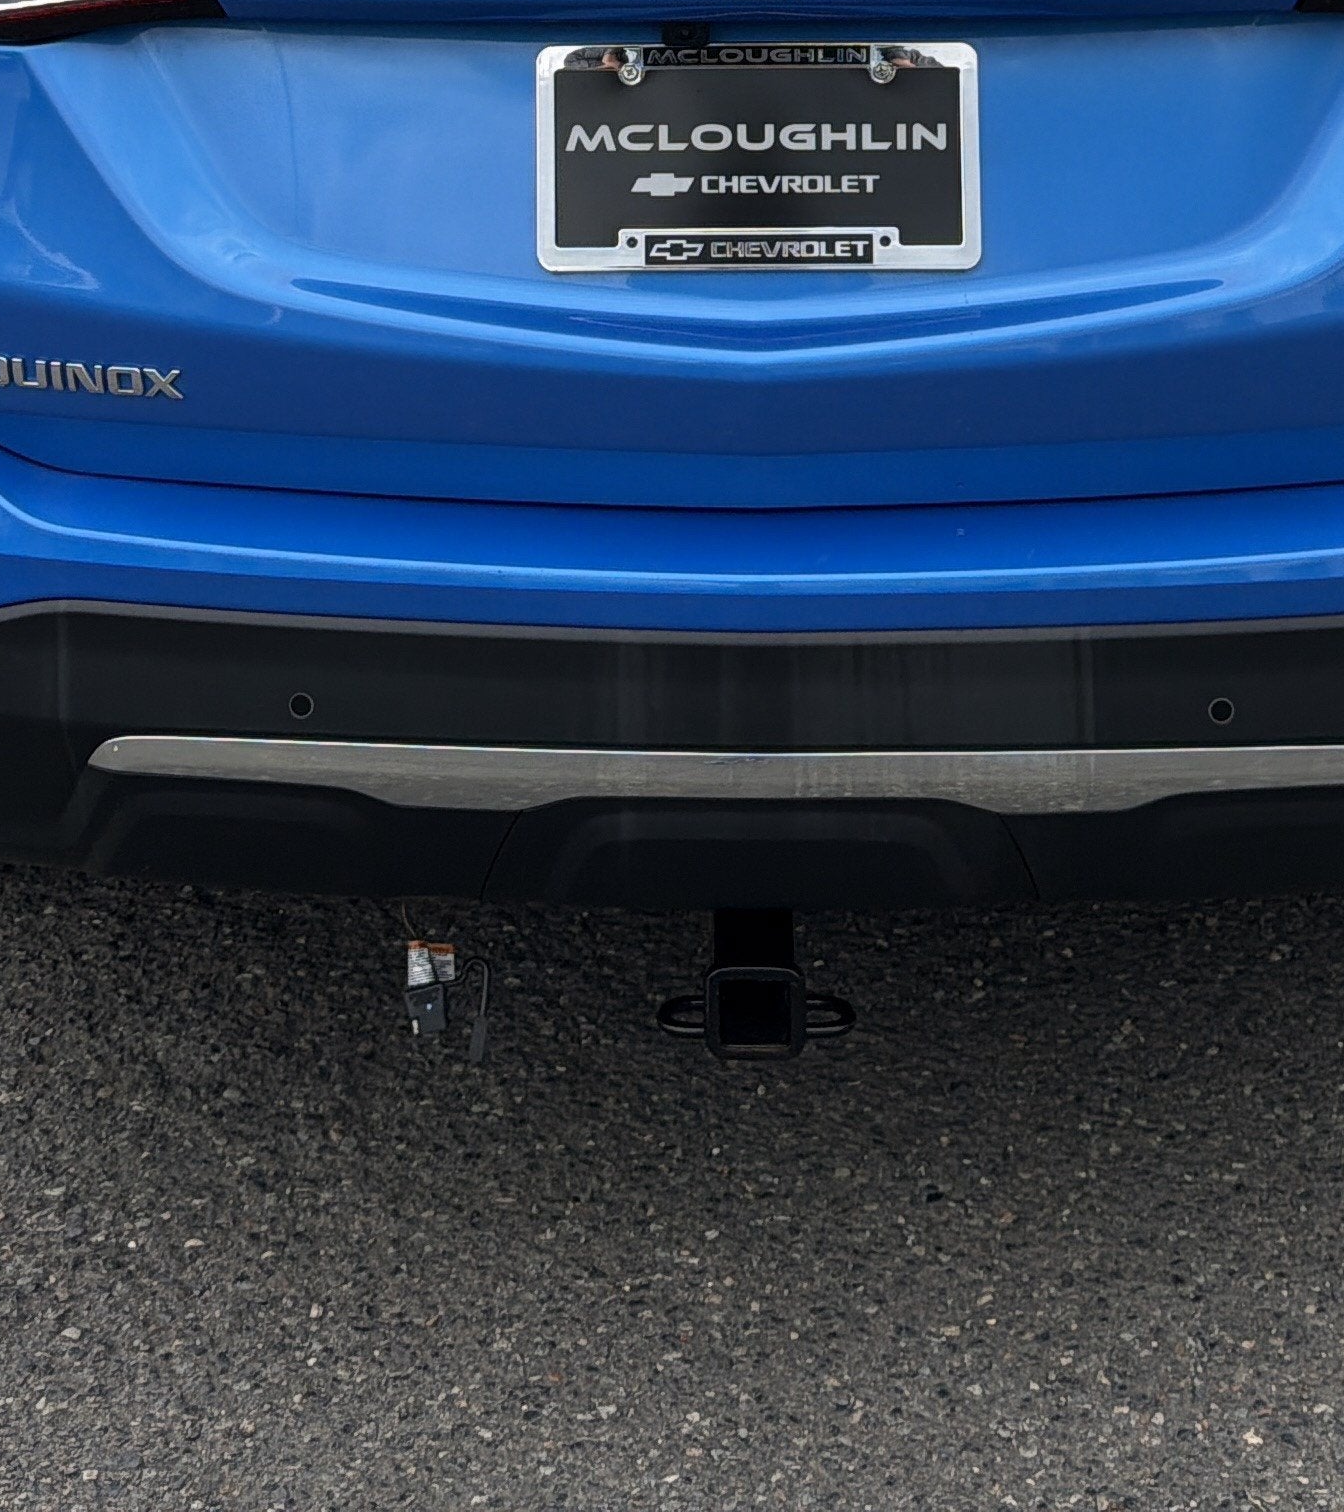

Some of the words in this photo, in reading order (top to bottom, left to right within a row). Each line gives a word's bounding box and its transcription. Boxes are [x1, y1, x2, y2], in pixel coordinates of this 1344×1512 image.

[647, 48, 867, 65] MCLOUGHLIN
[565, 123, 947, 152] MCLOUGHLIN
[700, 174, 881, 194] CHEVROLET
[710, 240, 870, 258] CHEVROLET
